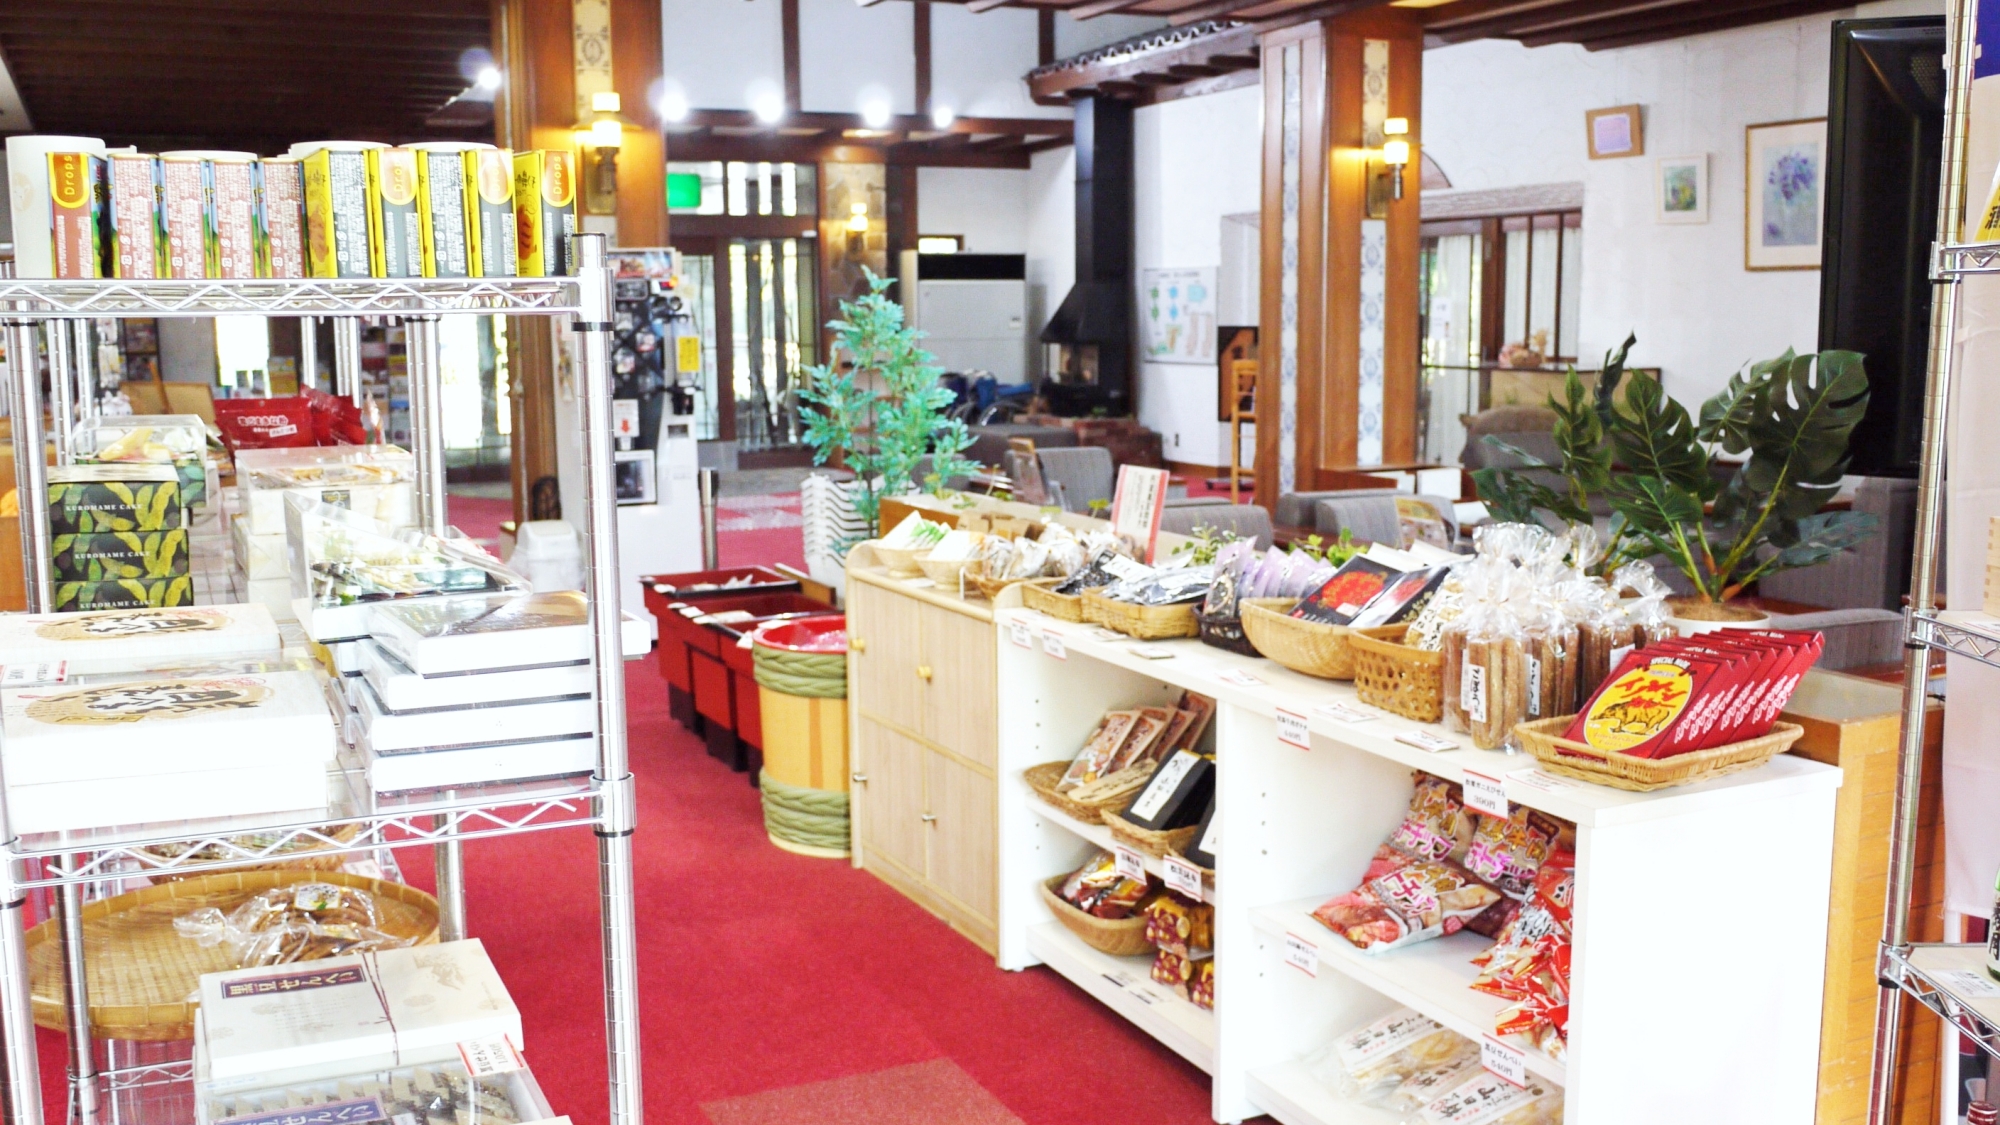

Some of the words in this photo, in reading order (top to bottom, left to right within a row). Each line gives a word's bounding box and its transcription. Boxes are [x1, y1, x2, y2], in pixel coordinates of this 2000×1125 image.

[63, 154, 75, 196] Drops
[552, 155, 563, 195] Drops
[65, 503, 117, 512] KUROMAME
[119, 503, 143, 511] CAKE
[74, 551, 125, 560] KUROMAME
[127, 550, 151, 559] CAKE
[79, 600, 130, 609] KUROMAME
[132, 599, 156, 607] CAKE
[229, 970, 359, 998] 黒豆せんべい
